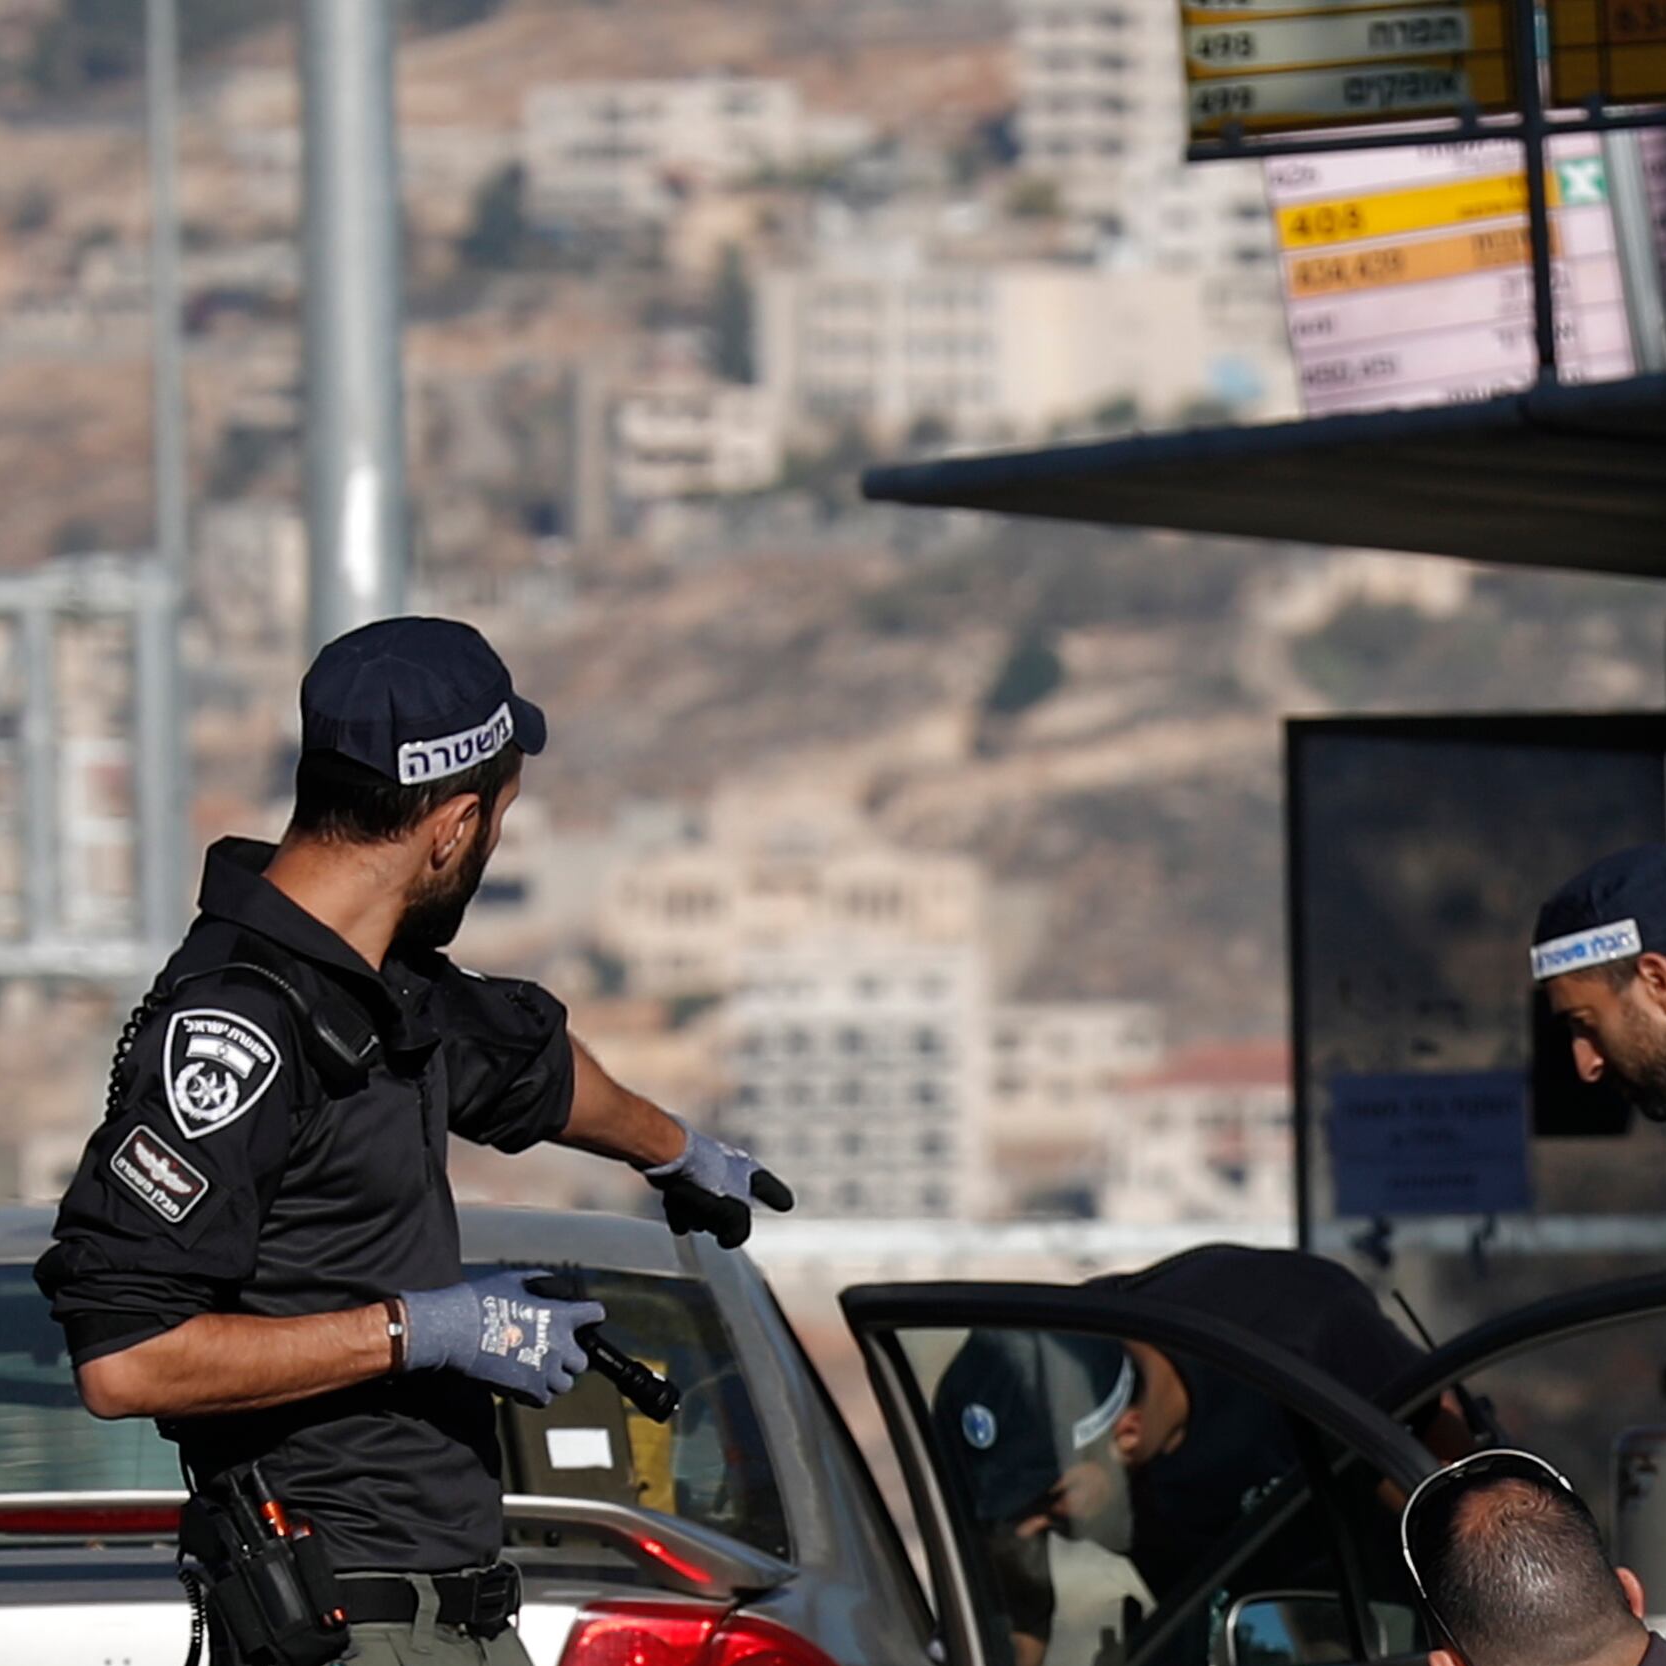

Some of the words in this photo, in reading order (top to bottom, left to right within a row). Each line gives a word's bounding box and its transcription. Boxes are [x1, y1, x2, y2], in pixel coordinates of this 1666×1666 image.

[407, 716, 511, 778] משטרה
[183, 1018, 229, 1036] ישראל
[226, 1025, 271, 1064] משטרת
[116, 1156, 155, 1195] משטרה
[151, 1186, 181, 1217] חבלן
